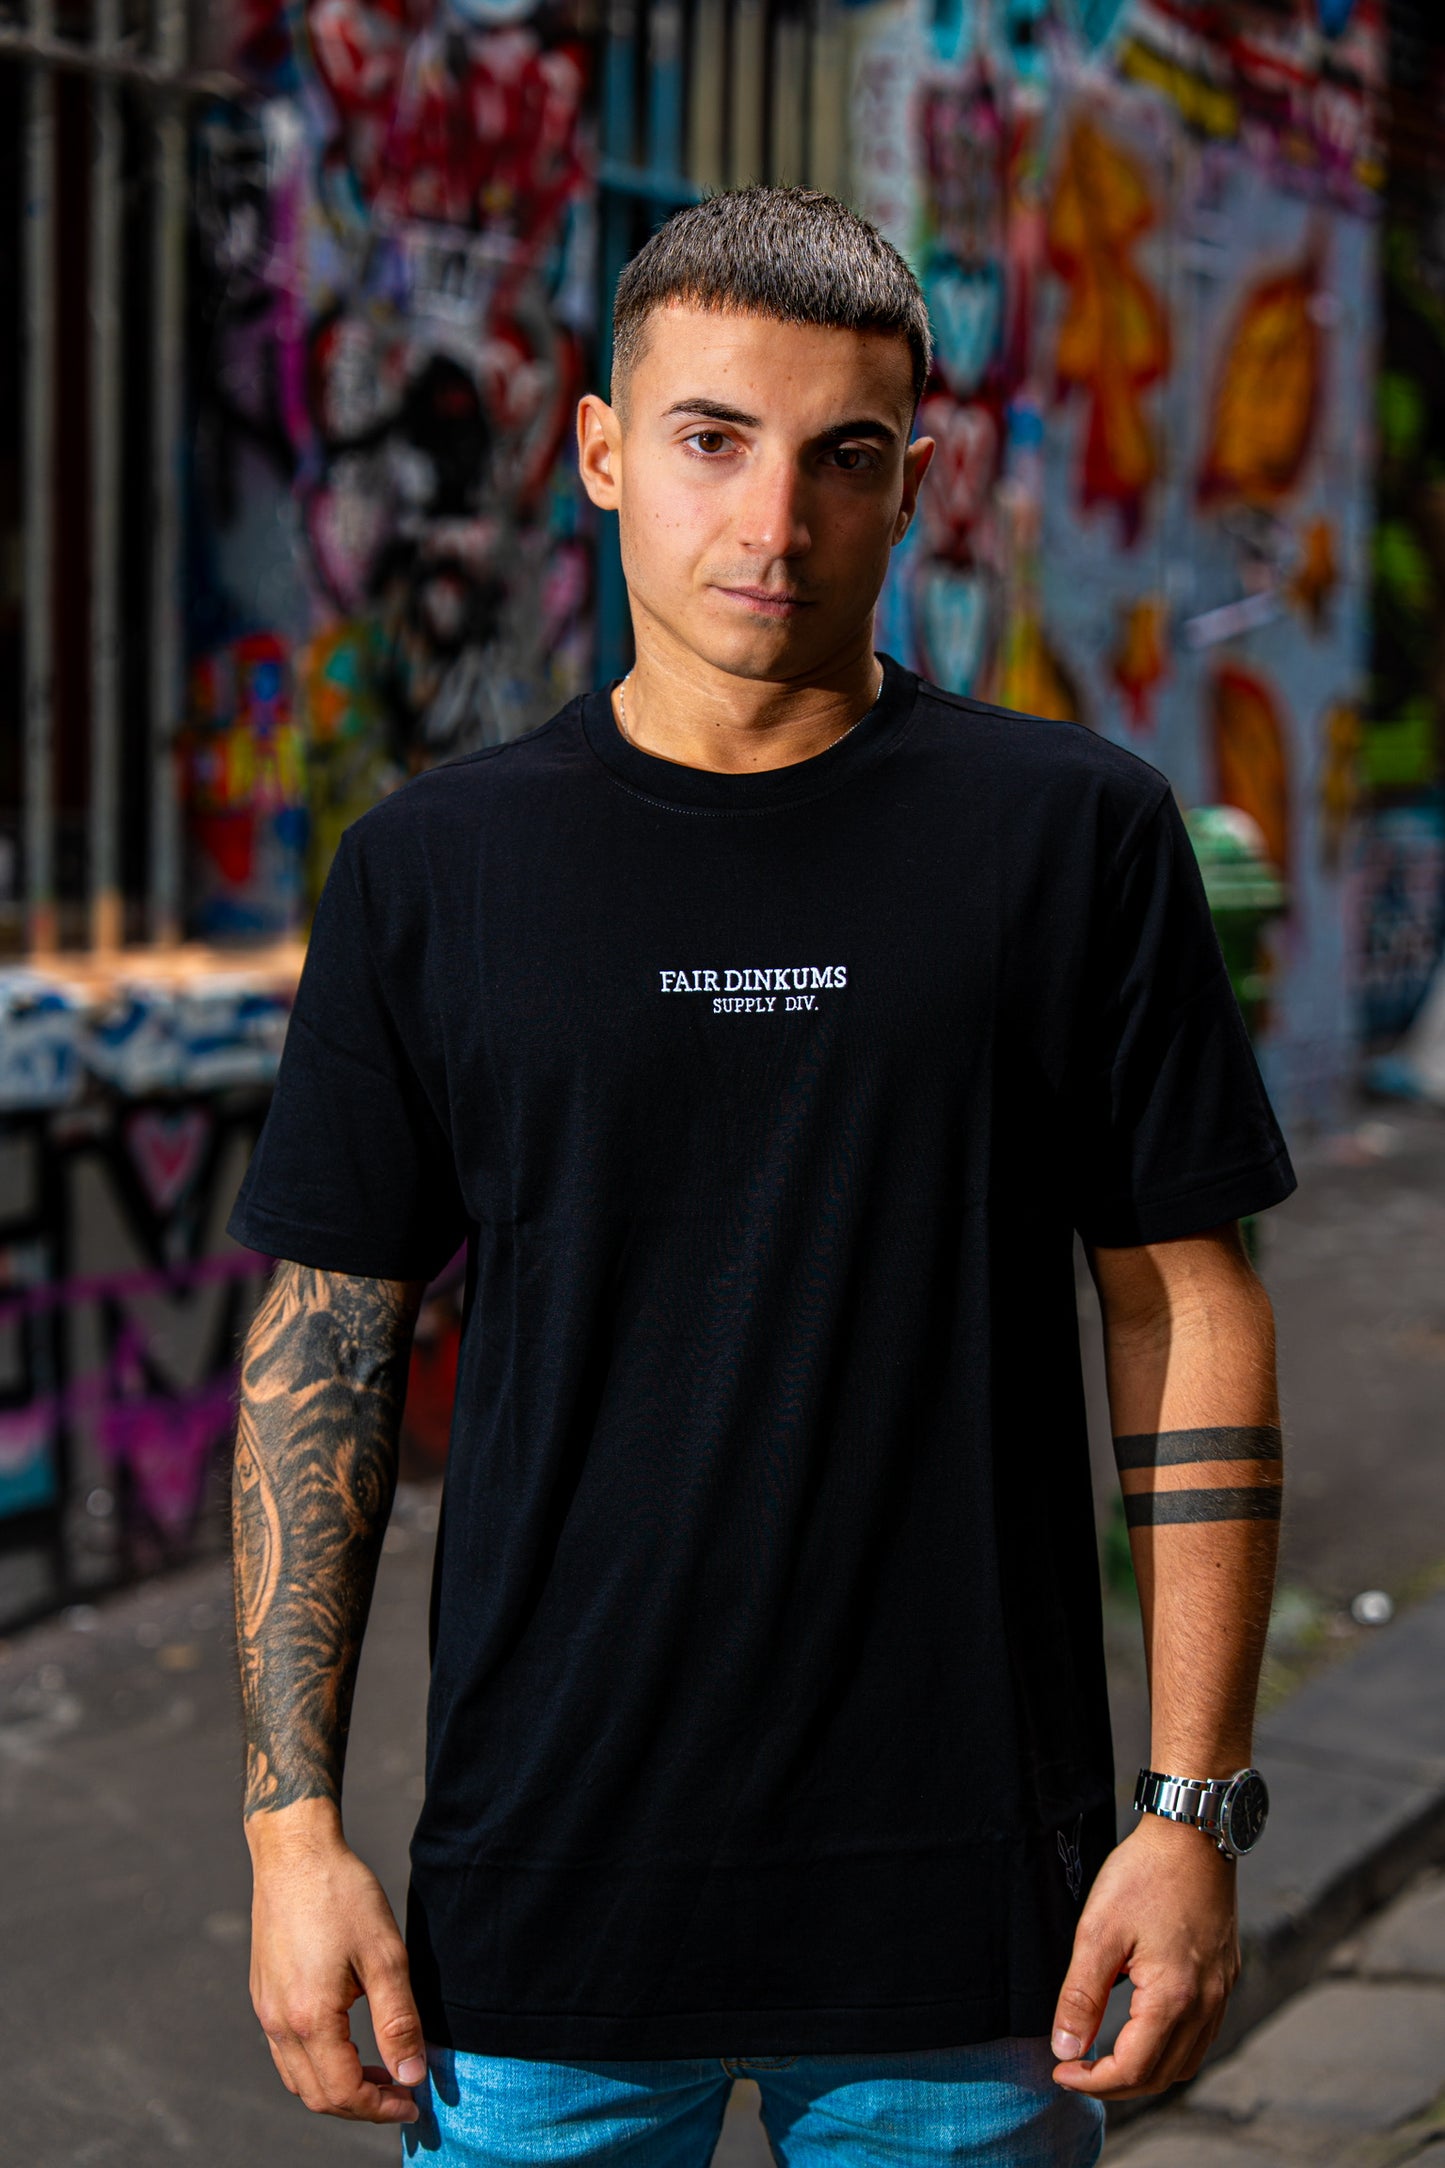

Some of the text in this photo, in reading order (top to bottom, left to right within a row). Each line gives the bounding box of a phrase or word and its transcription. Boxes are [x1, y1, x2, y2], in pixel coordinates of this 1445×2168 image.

[659, 966, 847, 992] FAIR DINKUMS
[713, 995, 819, 1013] SUPPLY DIV.
